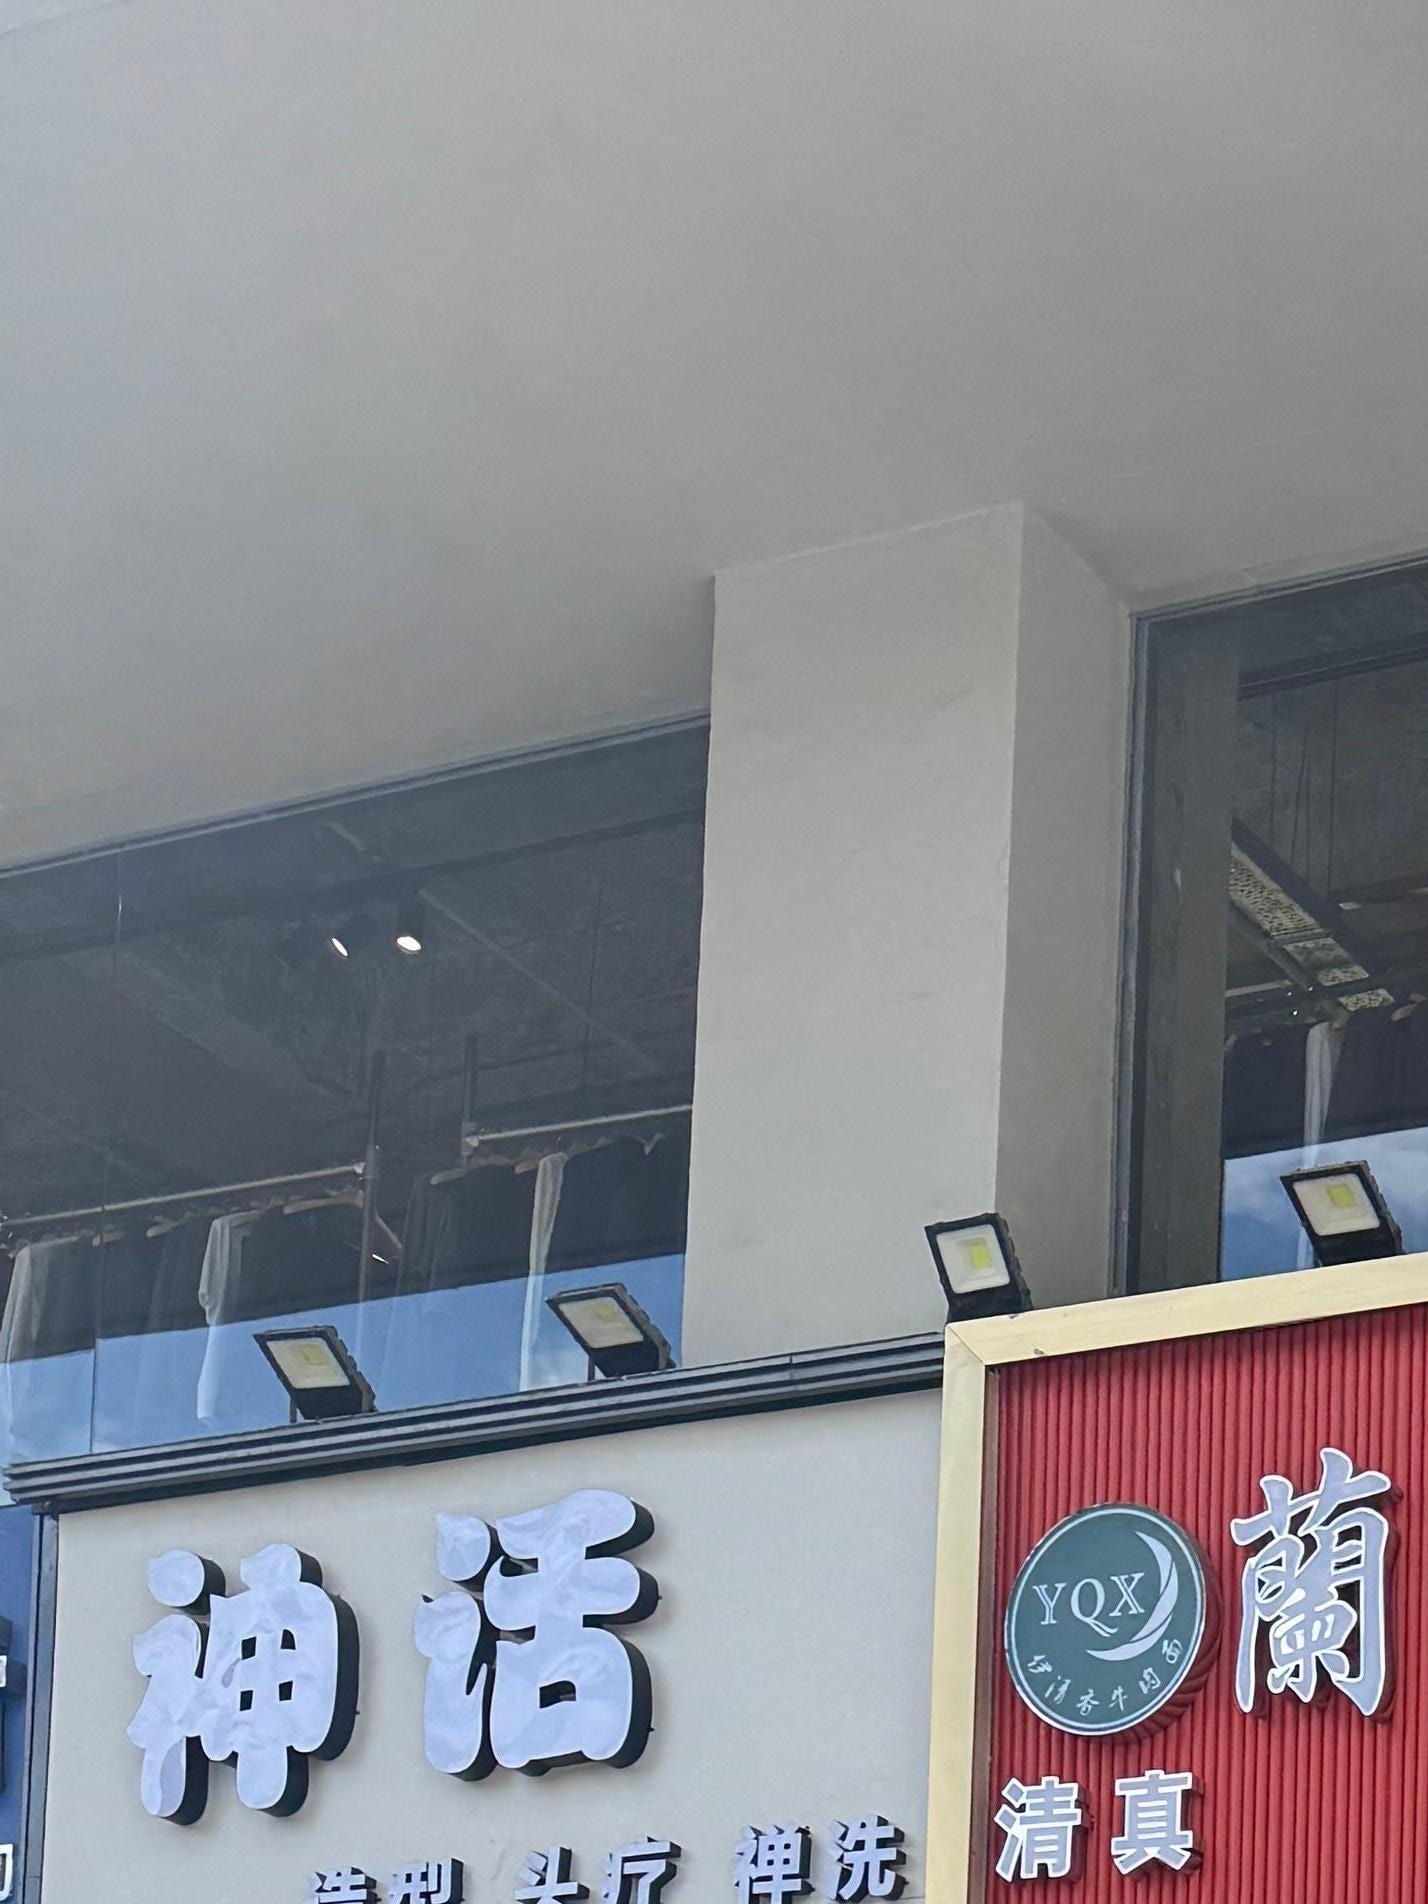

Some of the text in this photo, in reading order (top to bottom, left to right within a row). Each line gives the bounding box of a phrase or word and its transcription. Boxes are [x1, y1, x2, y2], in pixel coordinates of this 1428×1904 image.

[127, 1489, 655, 1822] 神话
[1033, 1573, 1145, 1637] YQX
[995, 1768, 1195, 1882] 清真
